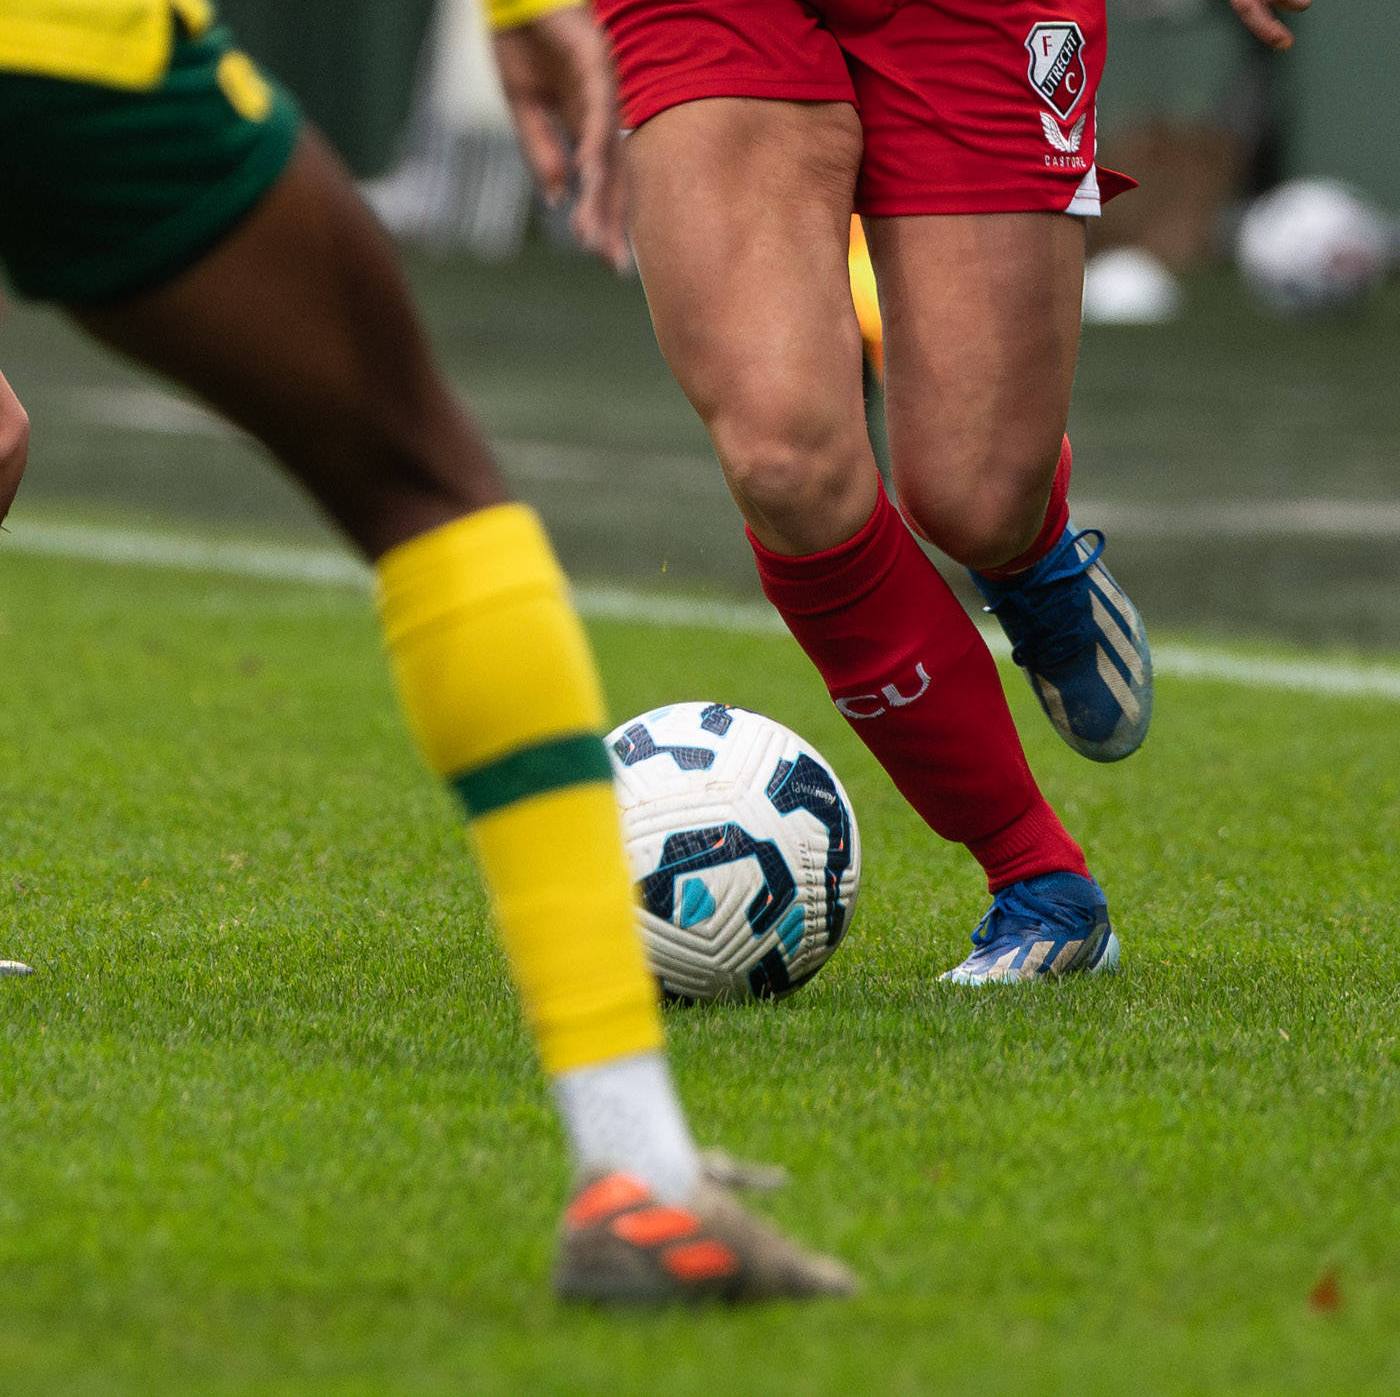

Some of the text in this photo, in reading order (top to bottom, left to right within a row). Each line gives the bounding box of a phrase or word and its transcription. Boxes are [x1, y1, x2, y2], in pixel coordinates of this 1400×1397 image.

[1041, 35, 1053, 57] F
[1041, 31, 1080, 98] UTRECHT
[1064, 71, 1077, 95] C
[1044, 154, 1087, 168] CASTORE
